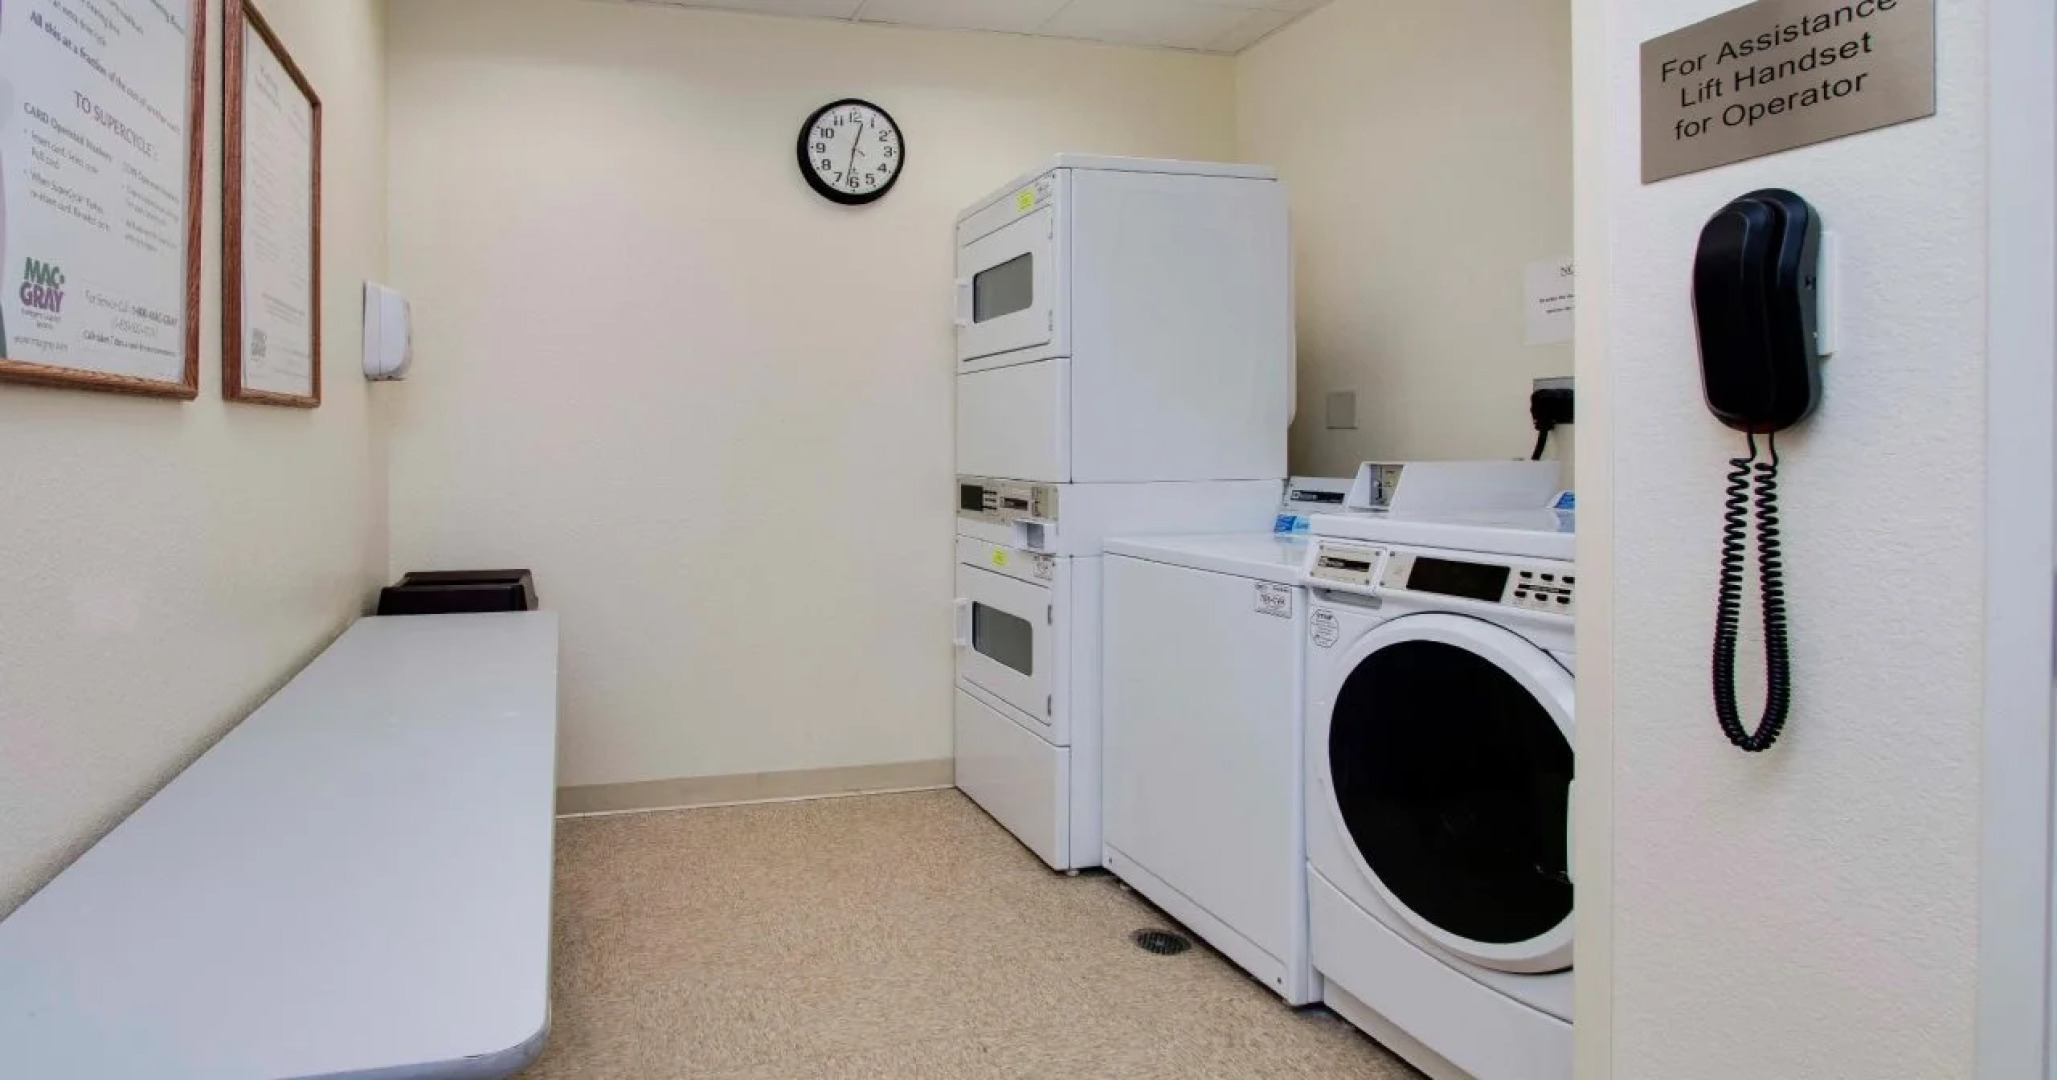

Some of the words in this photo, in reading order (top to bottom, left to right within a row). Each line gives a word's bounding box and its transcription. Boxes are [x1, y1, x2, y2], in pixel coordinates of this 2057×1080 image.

[30, 10, 43, 28] All
[45, 22, 61, 41] this
[1661, 53, 1707, 82] For
[1716, 0, 1898, 64] Assistance
[1681, 78, 1722, 108] Lift
[1734, 32, 1873, 92] Handset
[74, 89, 91, 114] TO
[1674, 116, 1712, 141] for
[1722, 72, 1868, 126] Operator
[23, 102, 49, 124] CARD
[849, 111, 862, 123] 12
[834, 115, 843, 126] 11
[870, 117, 875, 128] 1
[820, 128, 835, 139] 10
[879, 130, 888, 142] 2
[816, 142, 826, 154] 9
[884, 146, 893, 157] 3
[821, 159, 831, 170] 8
[877, 163, 887, 173] 4
[834, 171, 843, 182] 7
[849, 176, 859, 188] 6
[865, 173, 875, 185] 5
[19, 282, 64, 313] GRAY
